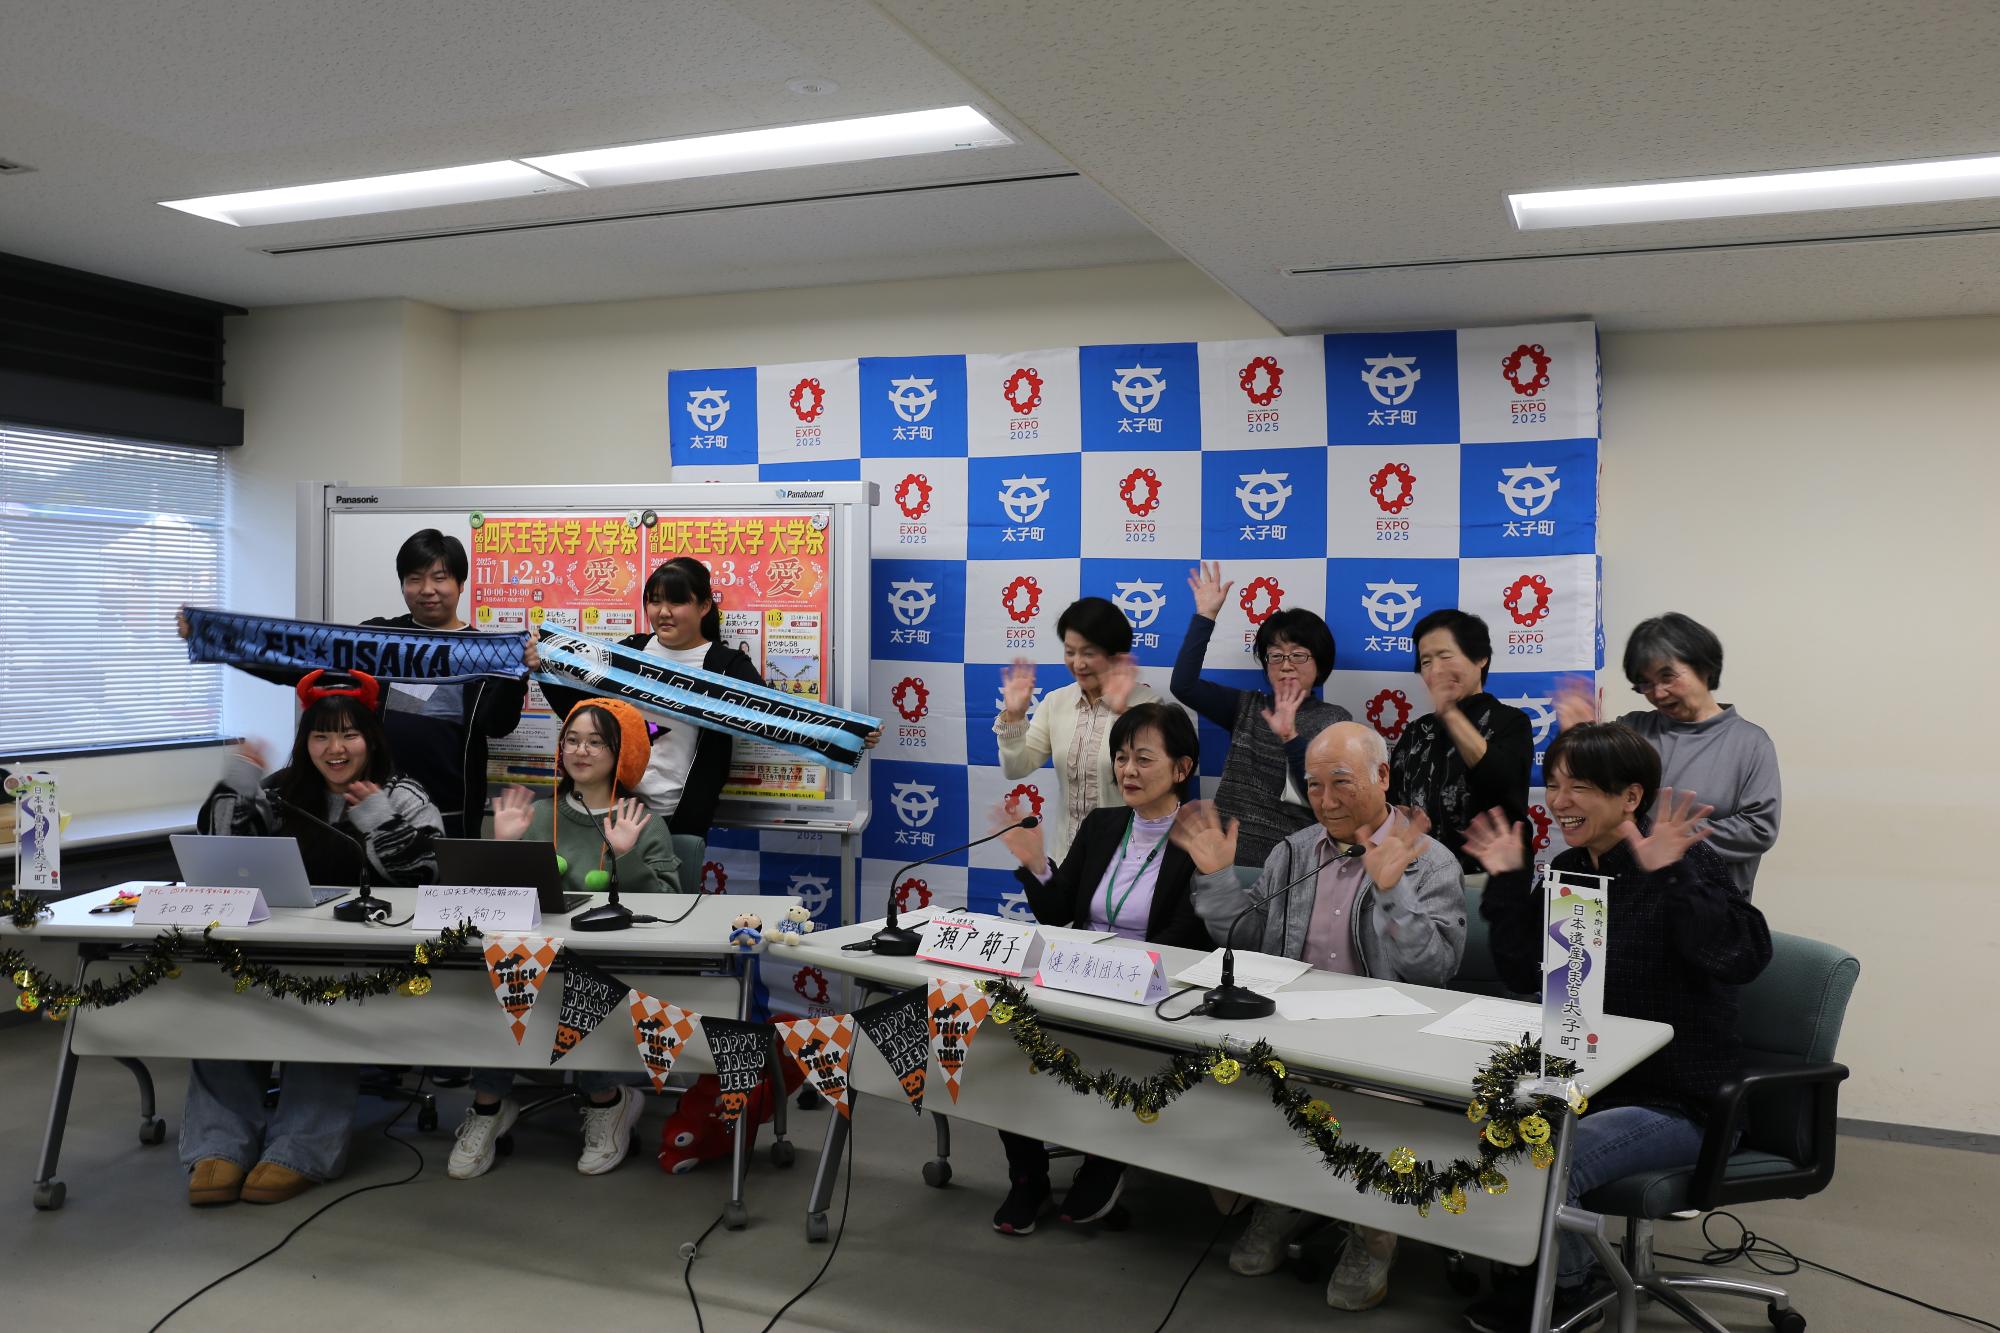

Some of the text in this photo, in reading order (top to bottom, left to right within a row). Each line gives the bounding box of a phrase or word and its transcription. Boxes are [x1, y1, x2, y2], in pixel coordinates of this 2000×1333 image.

[1511, 402, 1546, 413] EXPO
[1010, 419, 1039, 430] EXPO
[1247, 412, 1279, 422] EXPO
[1367, 409, 1417, 426] 太子町
[1512, 413, 1546, 424] 2025
[1117, 417, 1162, 433] 太子町
[1248, 423, 1279, 432] 2025
[795, 428, 821, 438] EXPO
[892, 425, 933, 441] 太子町
[1010, 430, 1039, 440] 2025
[690, 434, 728, 449] 太子町
[795, 438, 821, 447] 2025
[336, 495, 378, 504] Panasonic
[787, 490, 824, 499] Panaboard
[900, 525, 927, 535] EXPO
[1125, 523, 1156, 533] EXPO
[1239, 524, 1287, 541] 太子町
[1377, 521, 1409, 530] EXPO
[1502, 520, 1555, 537] 太子町
[485, 520, 581, 555] 四天王寺大学
[660, 519, 765, 555] 四天王寺大学
[900, 534, 927, 544] 2025
[1001, 527, 1044, 542] 太子町
[1125, 533, 1156, 543] 2025
[1377, 532, 1409, 541] 2025
[584, 557, 619, 596] 愛
[766, 557, 804, 598] 愛
[890, 629, 930, 645] 太子町
[1006, 630, 1035, 639] EXPO
[1131, 633, 1159, 648] 子町
[1508, 634, 1543, 643] EXPO
[767, 640, 798, 648] かりゆし58
[1006, 639, 1035, 649] 2025
[1365, 636, 1413, 652] 太子町
[1509, 645, 1542, 654] 2025
[333, 639, 452, 678] OSAKA
[899, 728, 927, 738] EXPO
[900, 738, 927, 747] 2025
[797, 831, 823, 840] 2025
[895, 831, 935, 847] 太子町
[934, 926, 1020, 964] 瀬戸節子
[1047, 951, 1142, 982] 健康劇団太子
[498, 967, 537, 984] TRICK
[1561, 904, 1586, 1051] 日本遺産のまち太子町
[508, 983, 525, 995] OR
[564, 971, 608, 1000] HAPPY
[502, 993, 534, 1007] TREAT
[568, 990, 610, 1018] HALLO
[559, 1006, 597, 1031] WEEN
[808, 1006, 835, 1016] EXPO
[870, 1003, 917, 1046] HAPPY
[935, 1021, 970, 1035] TRICK
[640, 1031, 676, 1049] TRICK
[709, 1033, 757, 1054] HAPPY
[887, 1021, 929, 1058] HALLO
[942, 1035, 958, 1048] OR
[648, 1043, 664, 1057] OR
[938, 1049, 965, 1063] TREAT
[643, 1053, 672, 1069] TREAT
[722, 1050, 765, 1072] HALLO
[804, 1050, 841, 1071] TRICK
[890, 1046, 929, 1079] WEEN
[817, 1066, 835, 1079] OR
[719, 1071, 758, 1091] WEEN
[816, 1075, 847, 1092] TREAT
